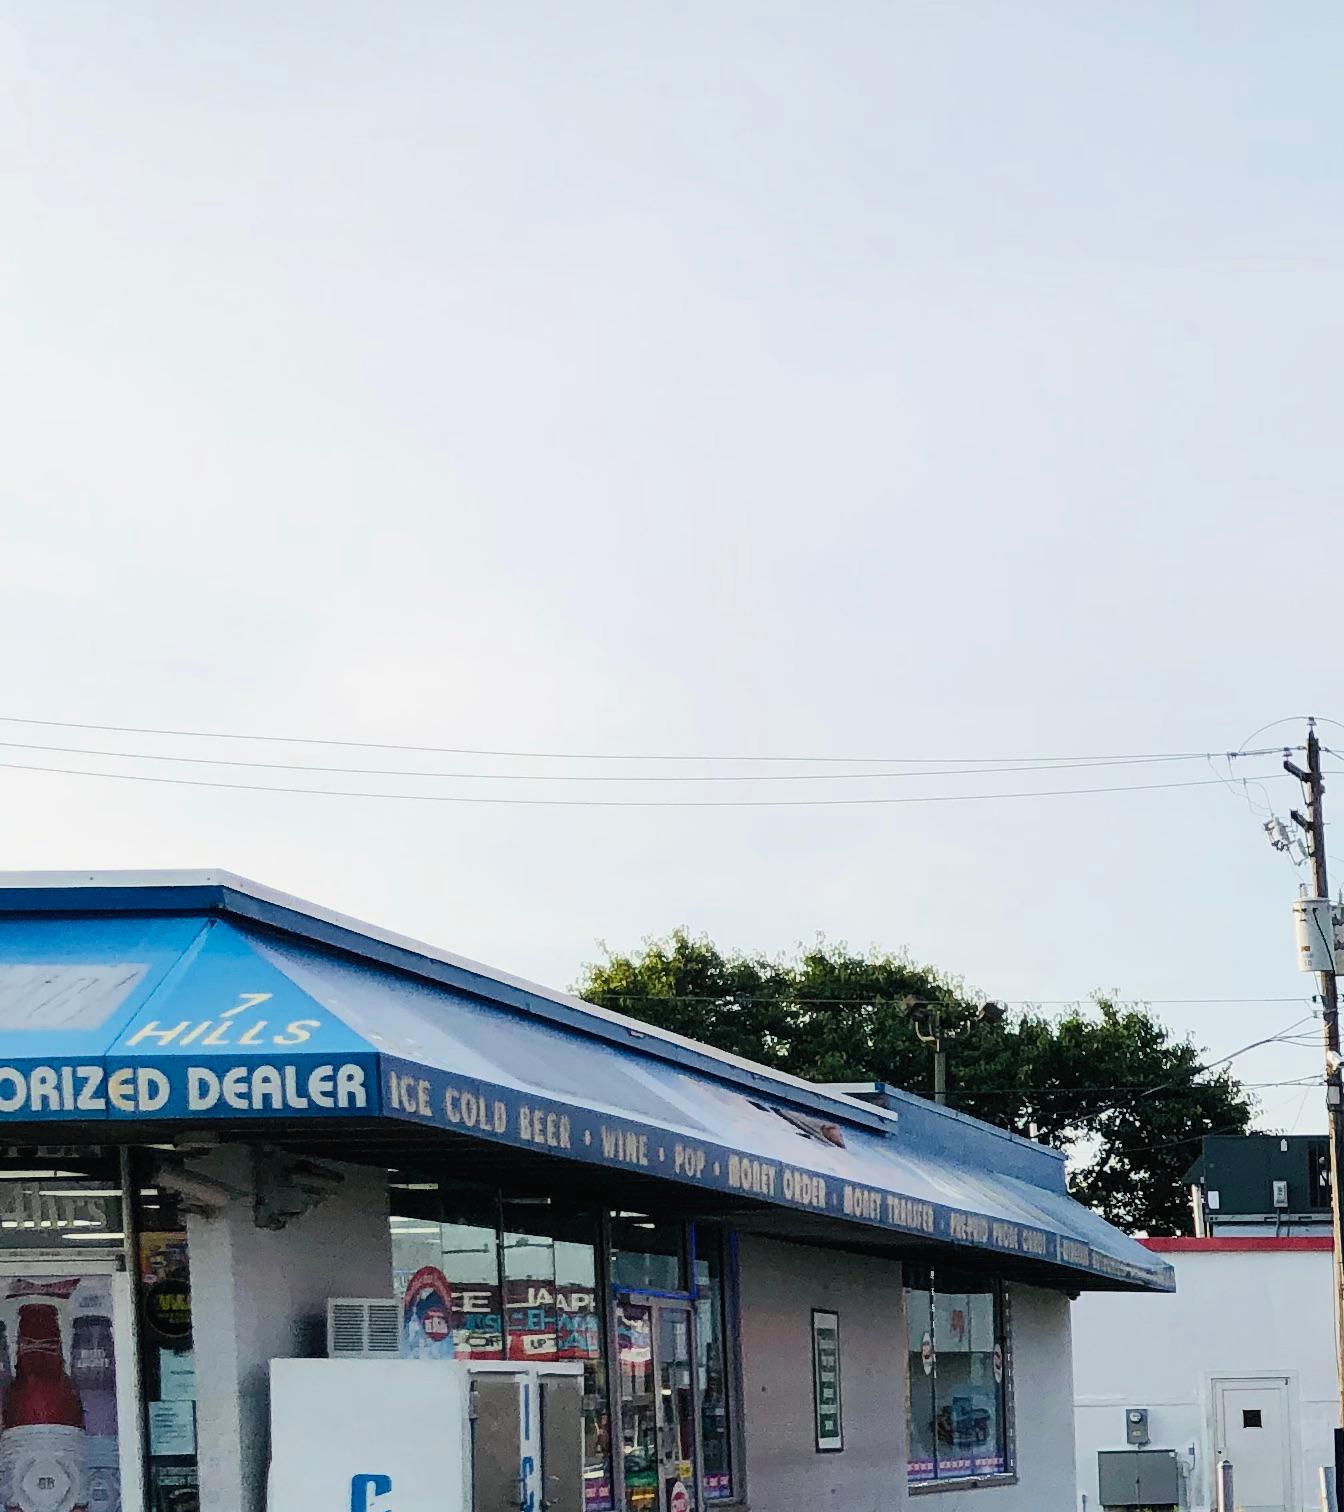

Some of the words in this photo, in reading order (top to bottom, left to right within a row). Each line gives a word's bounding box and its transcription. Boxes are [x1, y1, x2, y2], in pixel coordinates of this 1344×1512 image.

[220, 992, 274, 1018] 7
[125, 1020, 322, 1047] HILLS
[186, 1063, 368, 1112] DEALER
[387, 1070, 433, 1117] ICE
[444, 1086, 507, 1134] COLD
[518, 1104, 571, 1149] BEER
[601, 1125, 649, 1166] WINE
[674, 1143, 706, 1178] POP
[727, 1154, 776, 1197] MONEY
[782, 1169, 827, 1209] ORDER
[843, 1183, 882, 1221] MONEY
